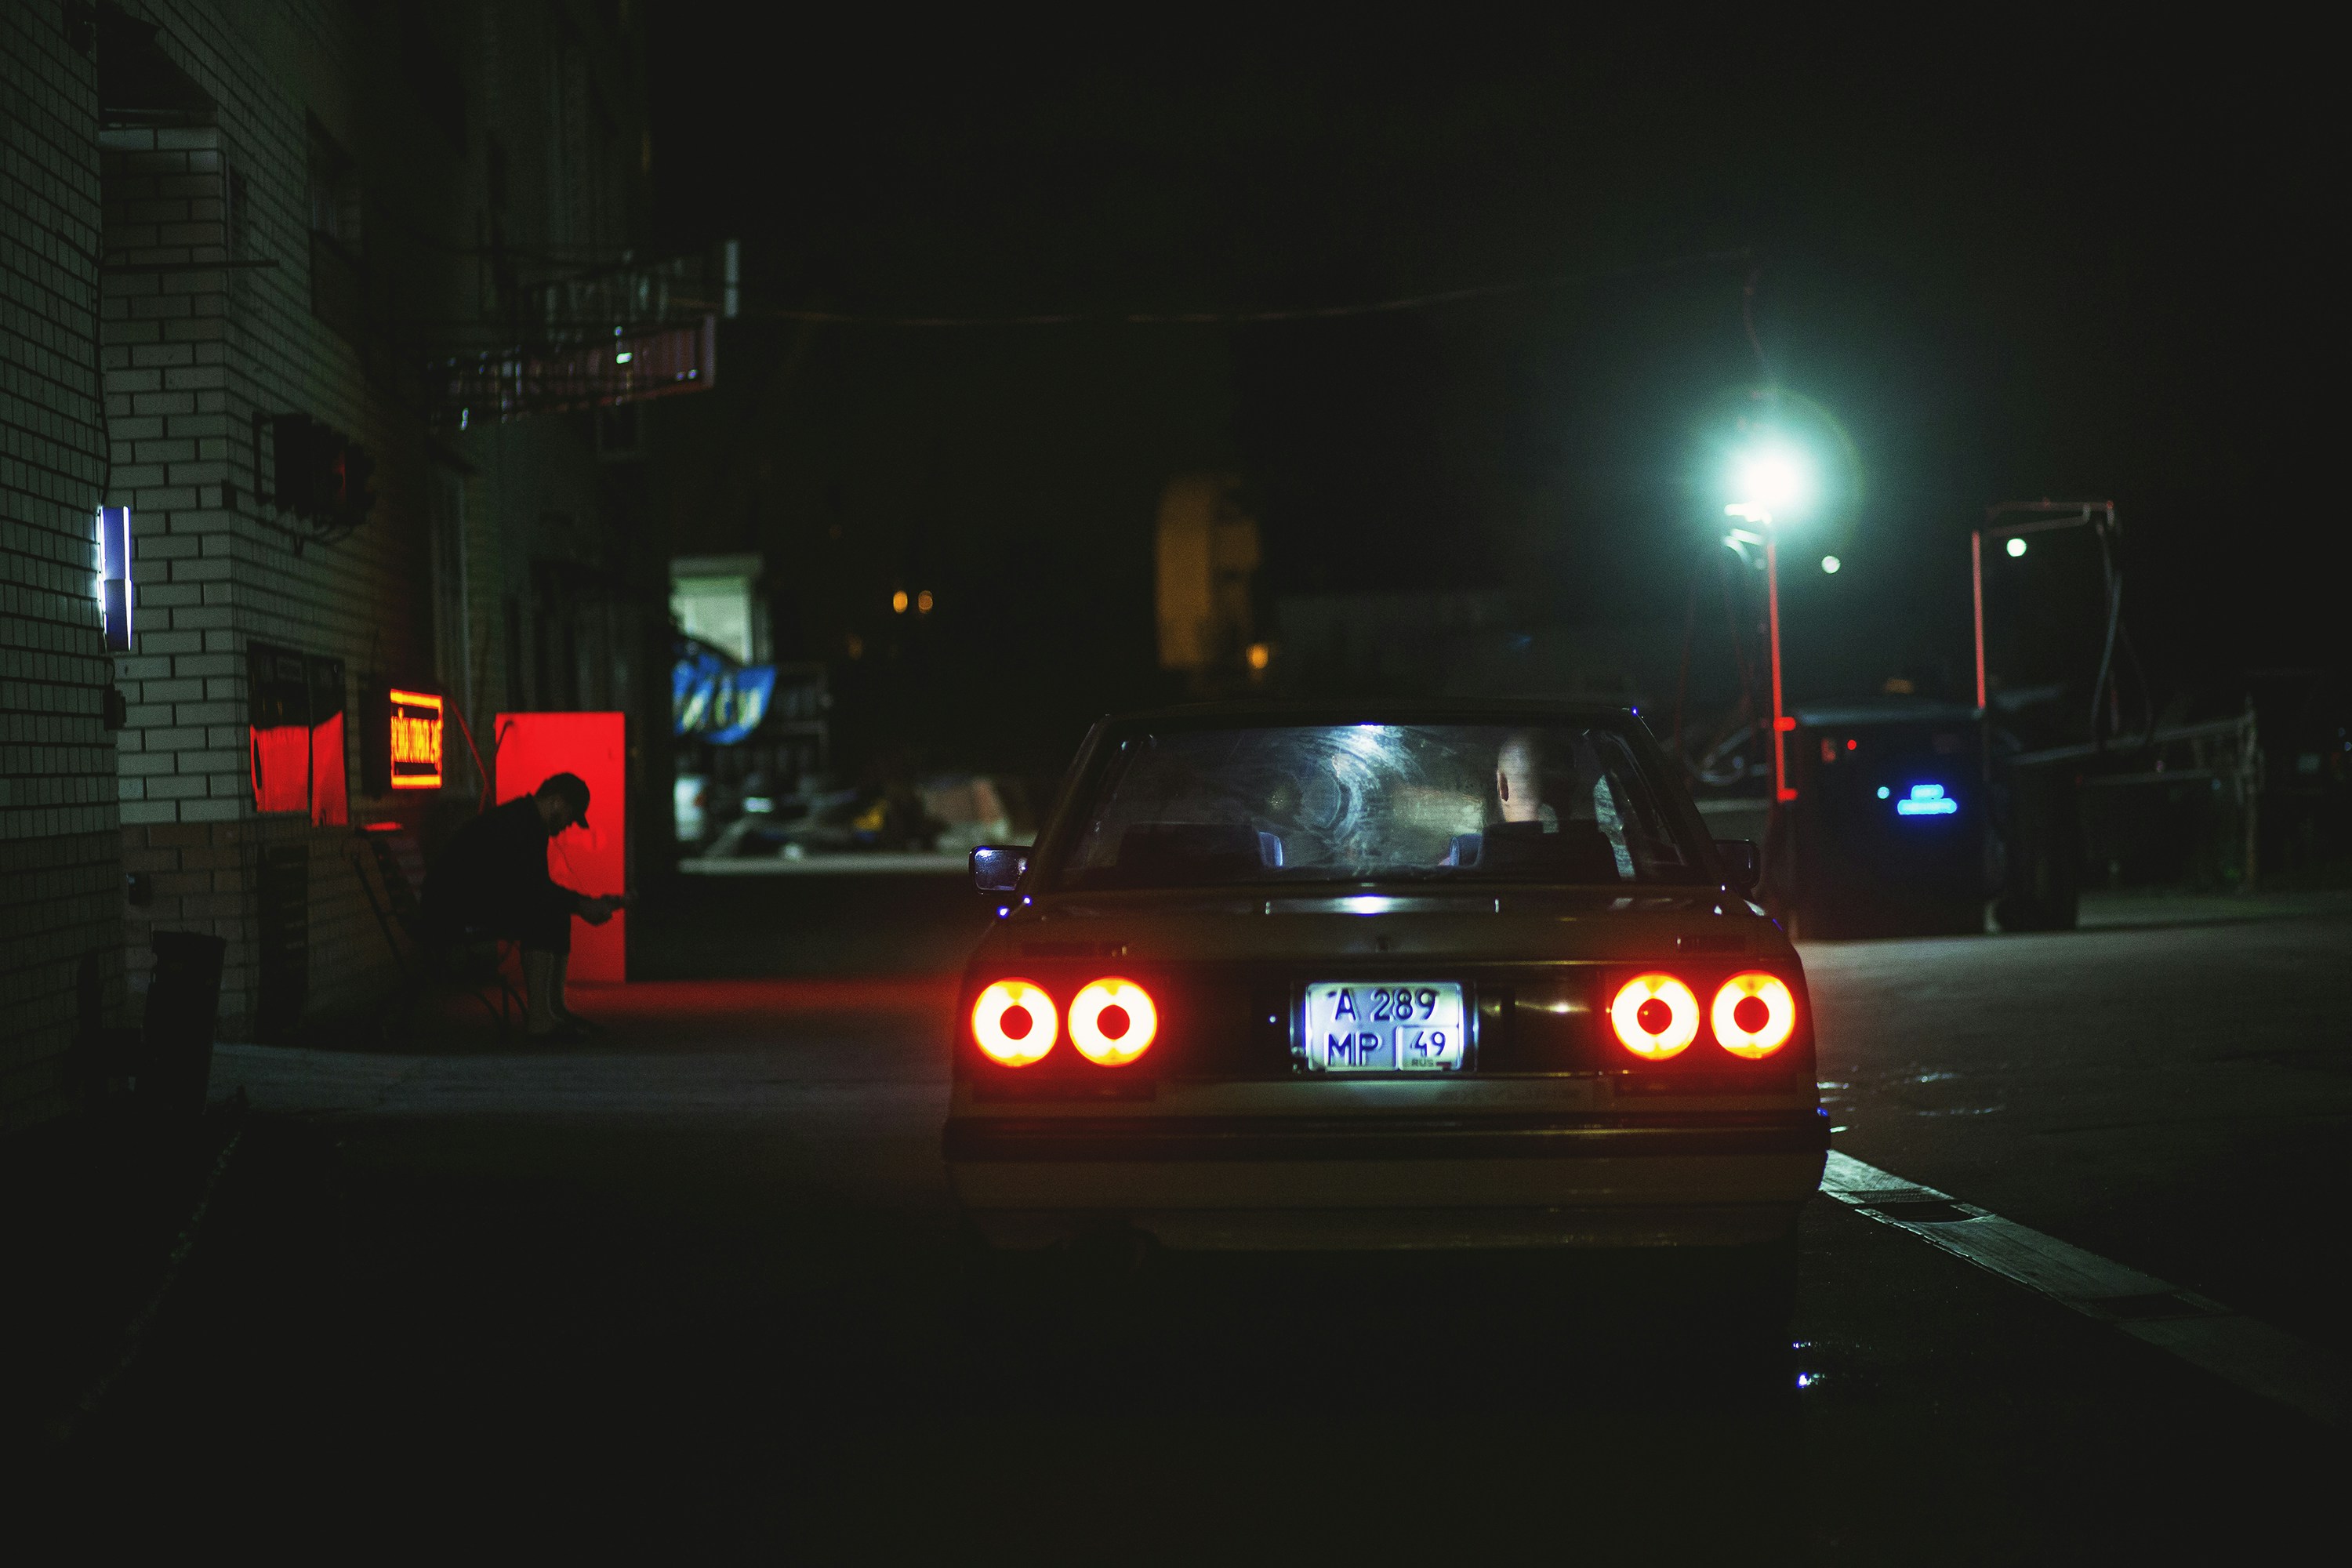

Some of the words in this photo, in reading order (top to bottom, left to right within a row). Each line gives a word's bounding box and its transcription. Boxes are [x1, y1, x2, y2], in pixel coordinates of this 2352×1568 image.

[1334, 988, 1356, 1021] A
[1373, 988, 1438, 1021] 289
[1327, 1032, 1379, 1065] MP
[1414, 1031, 1446, 1057] 49
[1411, 1058, 1434, 1067] RUS
